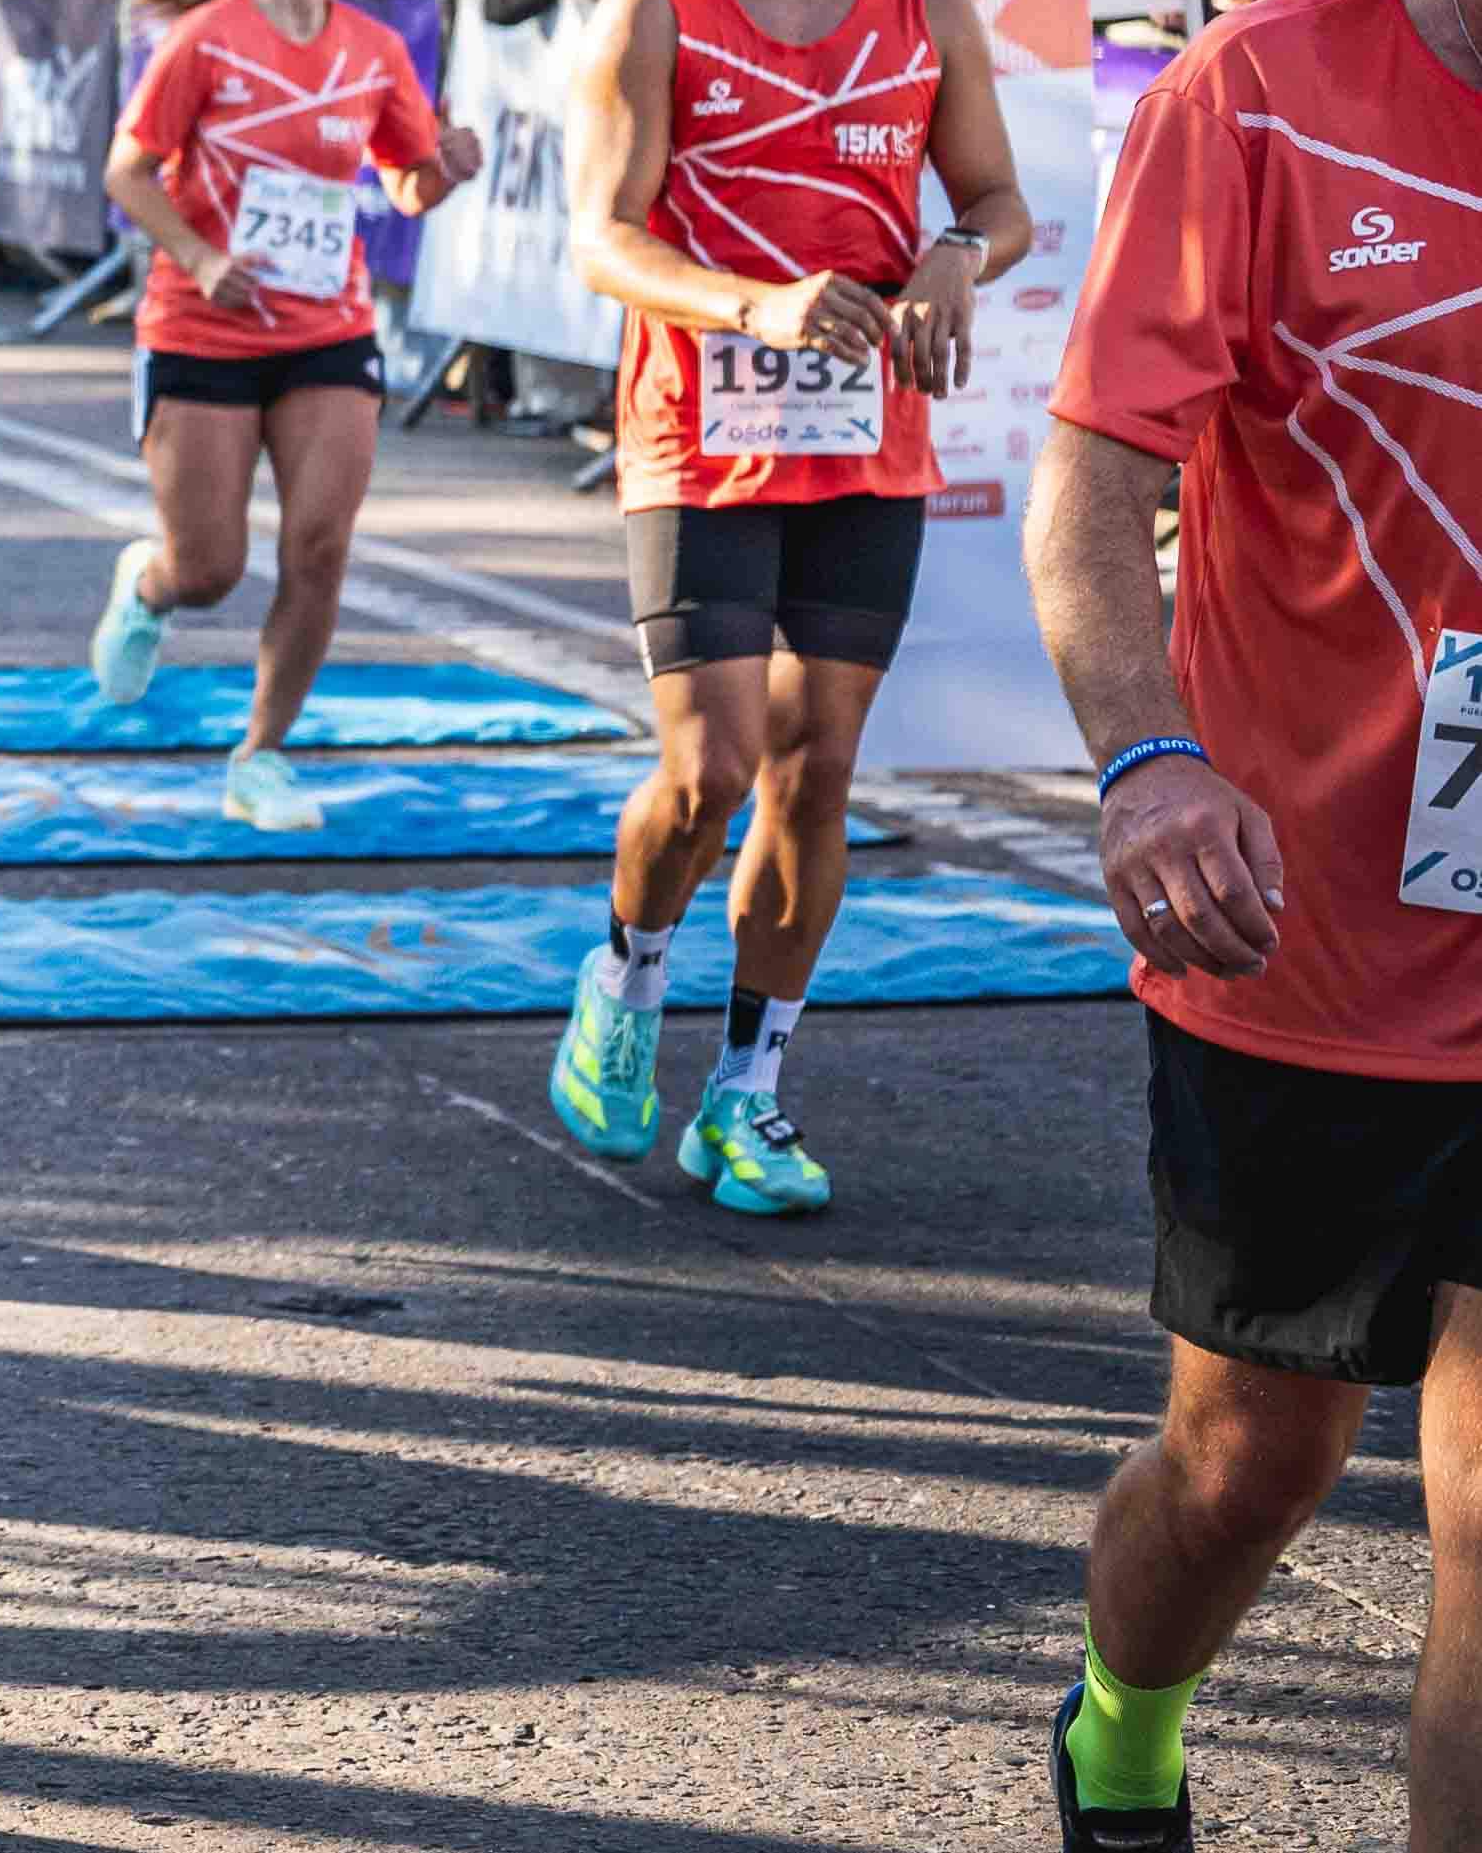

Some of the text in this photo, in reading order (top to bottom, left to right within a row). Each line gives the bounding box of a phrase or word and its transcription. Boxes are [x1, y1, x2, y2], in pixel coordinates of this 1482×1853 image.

[835, 124, 887, 155] 15K
[244, 208, 343, 254] 7345
[712, 344, 875, 394] 1932
